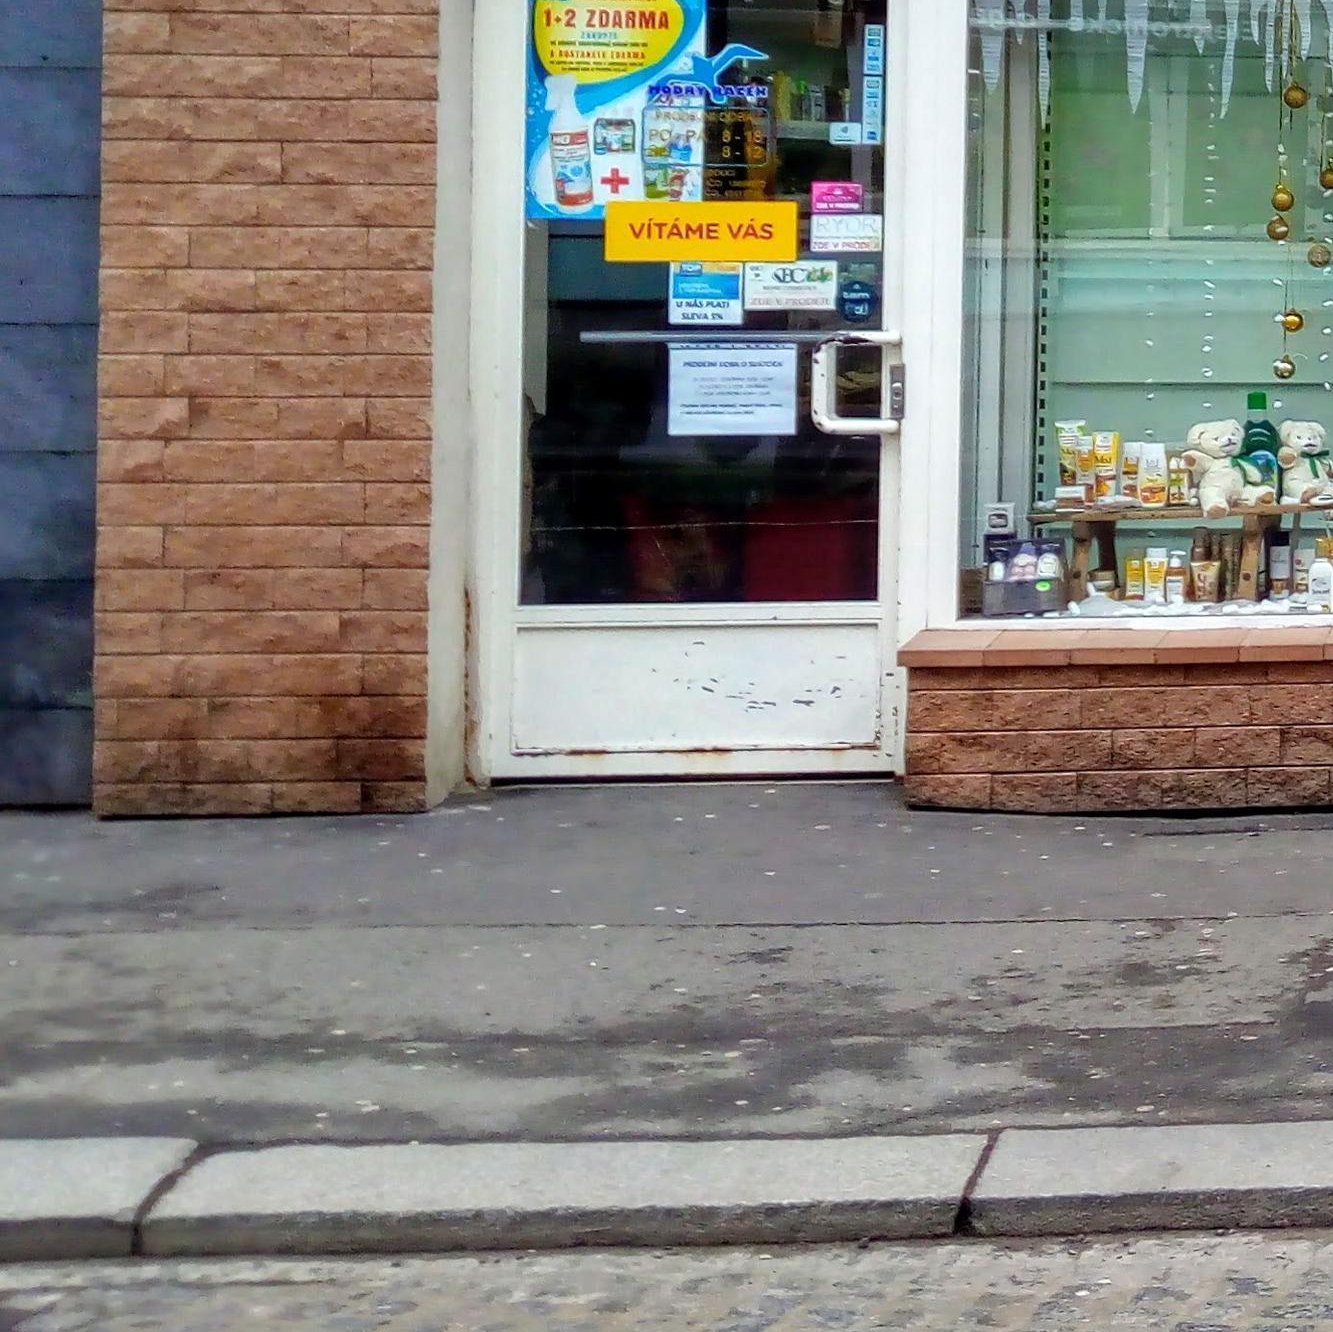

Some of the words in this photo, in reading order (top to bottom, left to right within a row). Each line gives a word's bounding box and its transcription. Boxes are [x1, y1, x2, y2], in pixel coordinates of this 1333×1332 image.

[544, 8, 576, 28] 1+2
[586, 9, 669, 29] ZDARMA
[629, 217, 719, 239] VÍTÁME
[723, 217, 774, 240] VÁS
[816, 218, 876, 233] RYOR
